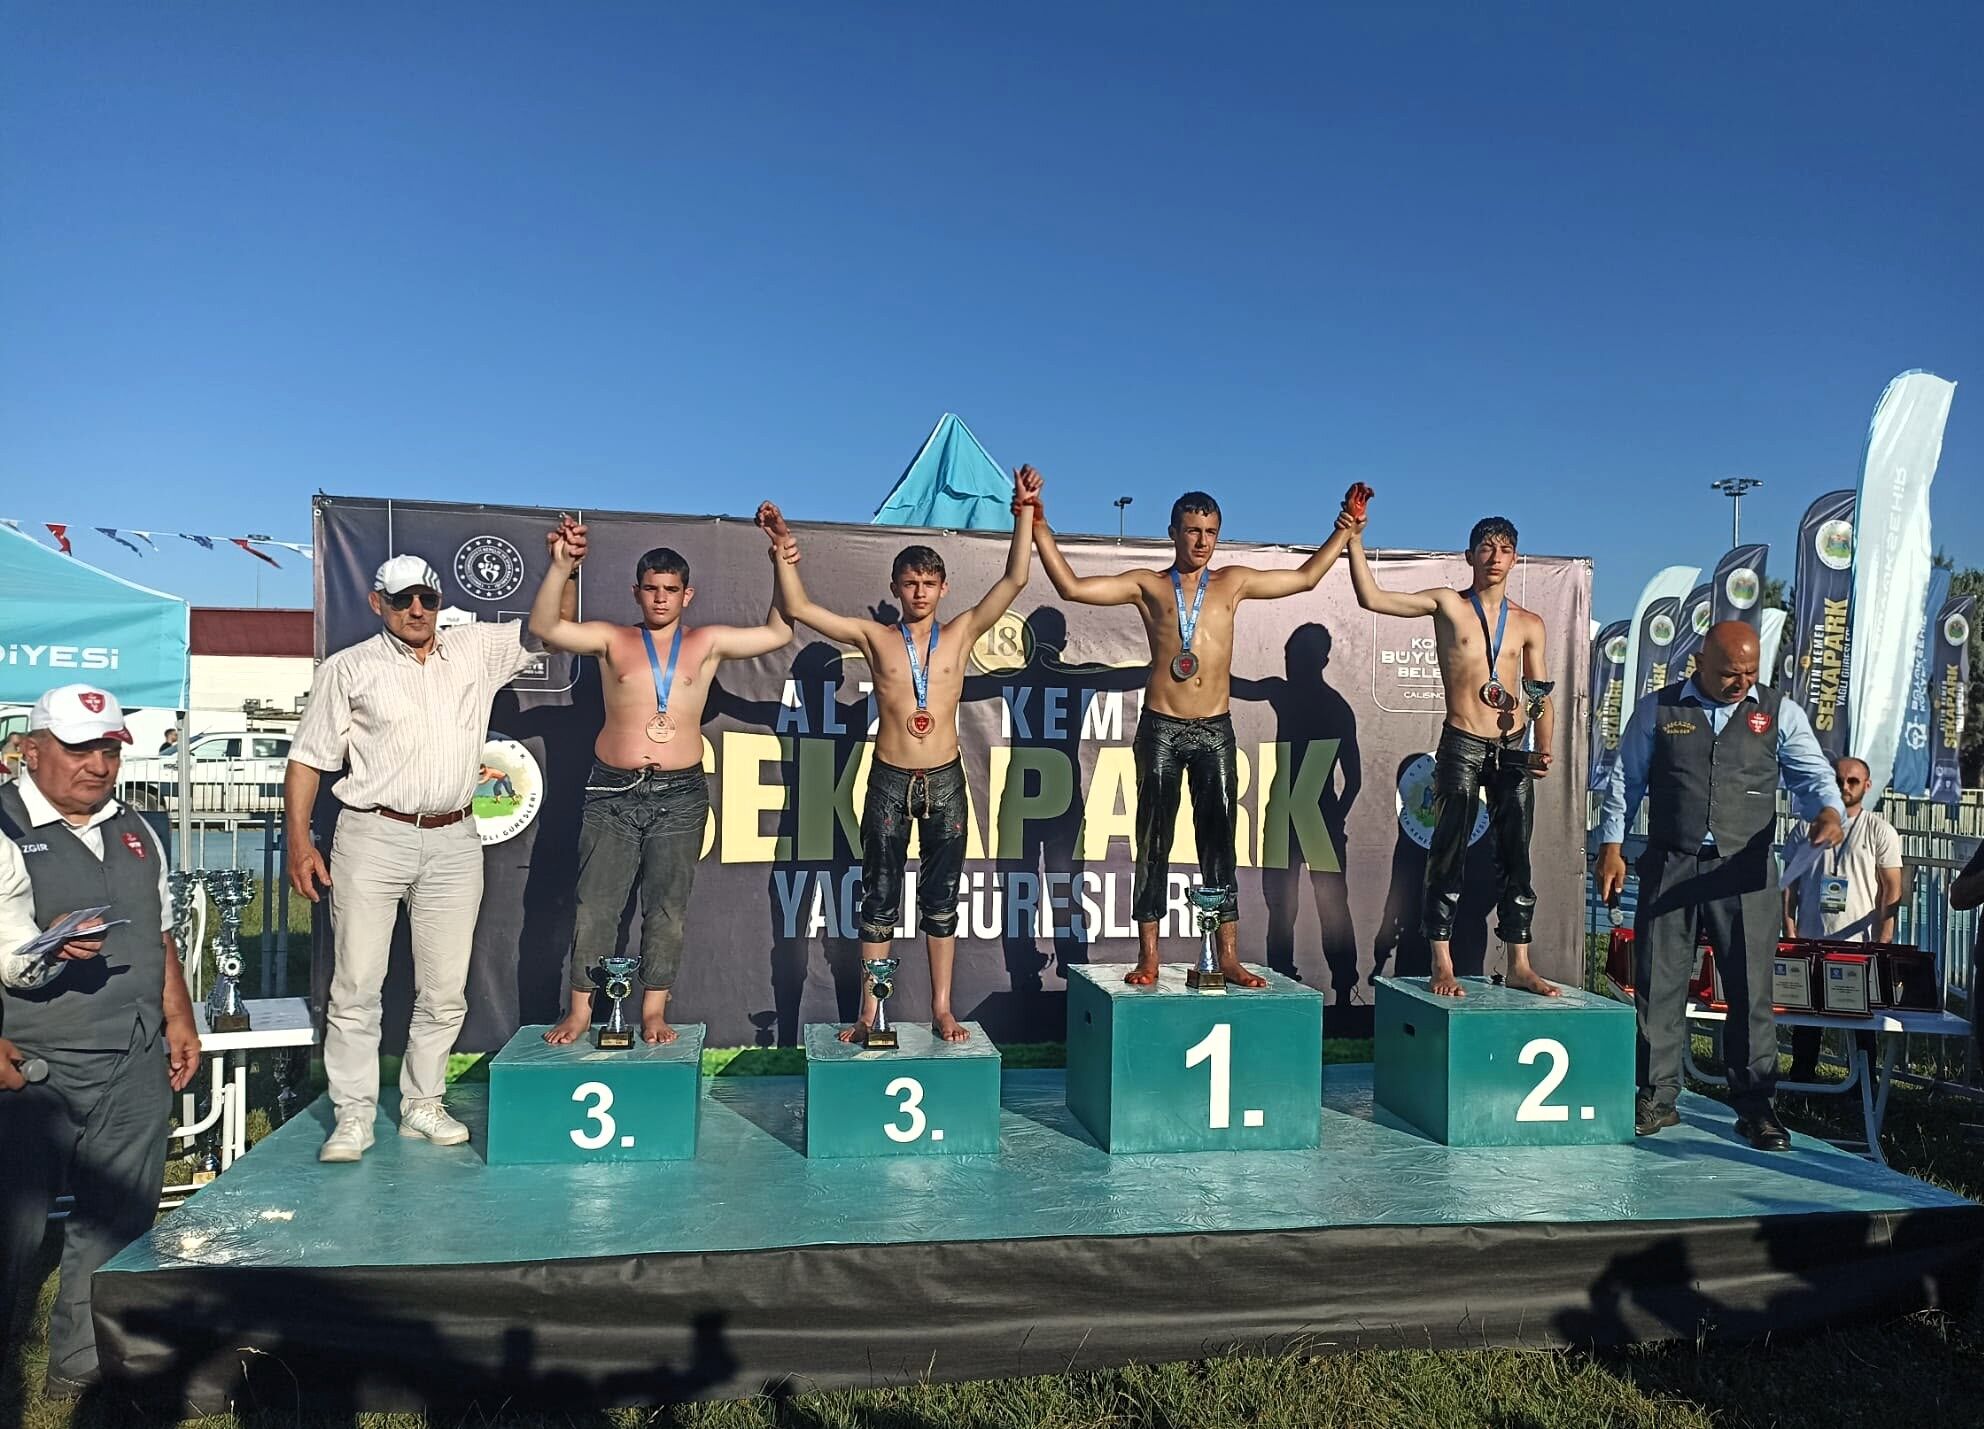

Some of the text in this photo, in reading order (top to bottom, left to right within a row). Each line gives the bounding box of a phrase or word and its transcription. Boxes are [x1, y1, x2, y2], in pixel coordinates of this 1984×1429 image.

[1381, 650, 1439, 664] BÜYÜ
[1398, 667, 1442, 679] BELE
[1411, 638, 1437, 649] KO
[1809, 624, 1825, 705] ALTIN KEMER
[1816, 597, 1848, 732] SEKAPARK
[1001, 686, 1147, 741] KEM
[1944, 664, 1958, 749] SEKAPARK
[698, 731, 1341, 872] EKPAK
[883, 1077, 944, 1143] 3.
[1185, 1023, 1264, 1129] 1.
[1516, 1038, 1595, 1122] 2.
[569, 1081, 635, 1150] 3.
